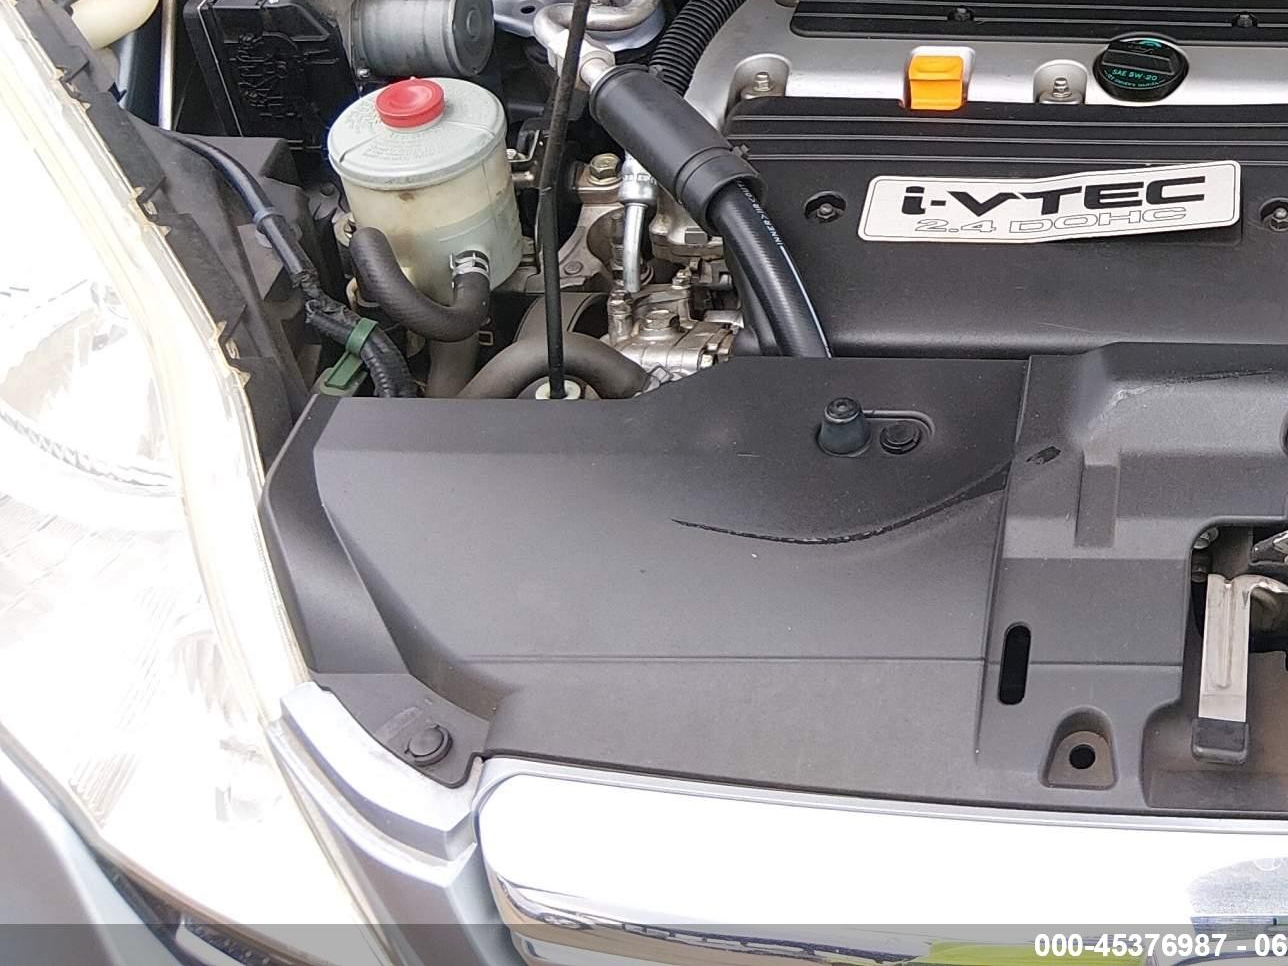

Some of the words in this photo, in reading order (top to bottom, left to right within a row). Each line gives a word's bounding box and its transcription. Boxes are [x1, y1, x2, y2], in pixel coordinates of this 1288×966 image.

[1111, 68, 1128, 77] SAE
[1128, 71, 1158, 82] 5W-20
[901, 175, 1206, 217] i-VTEC
[914, 218, 997, 234] 2.4
[1008, 206, 1187, 234] DOHC
